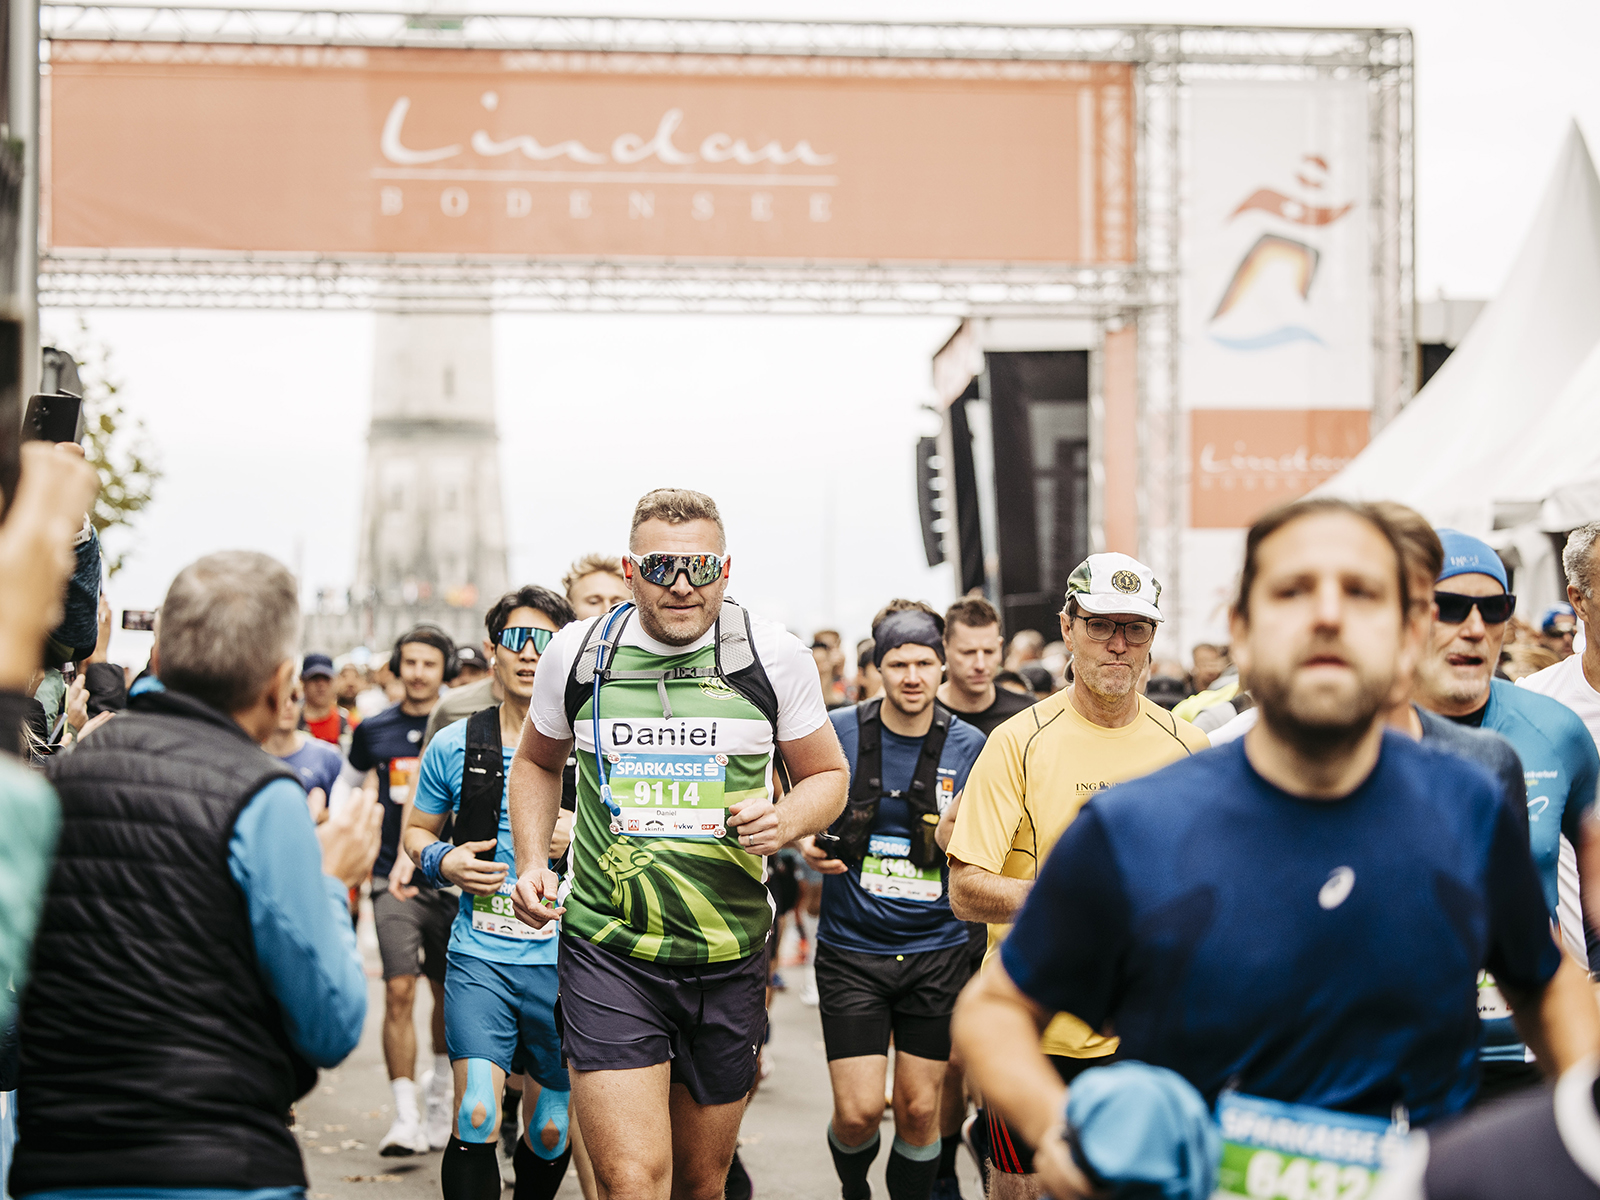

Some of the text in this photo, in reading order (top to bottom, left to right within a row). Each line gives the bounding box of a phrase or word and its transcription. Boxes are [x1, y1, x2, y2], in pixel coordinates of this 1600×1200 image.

[380, 91, 838, 165] Lindau
[611, 721, 718, 746] Daniel
[616, 762, 703, 777] SPARKASSE
[634, 781, 700, 806] 9114
[656, 809, 677, 817] Daniel
